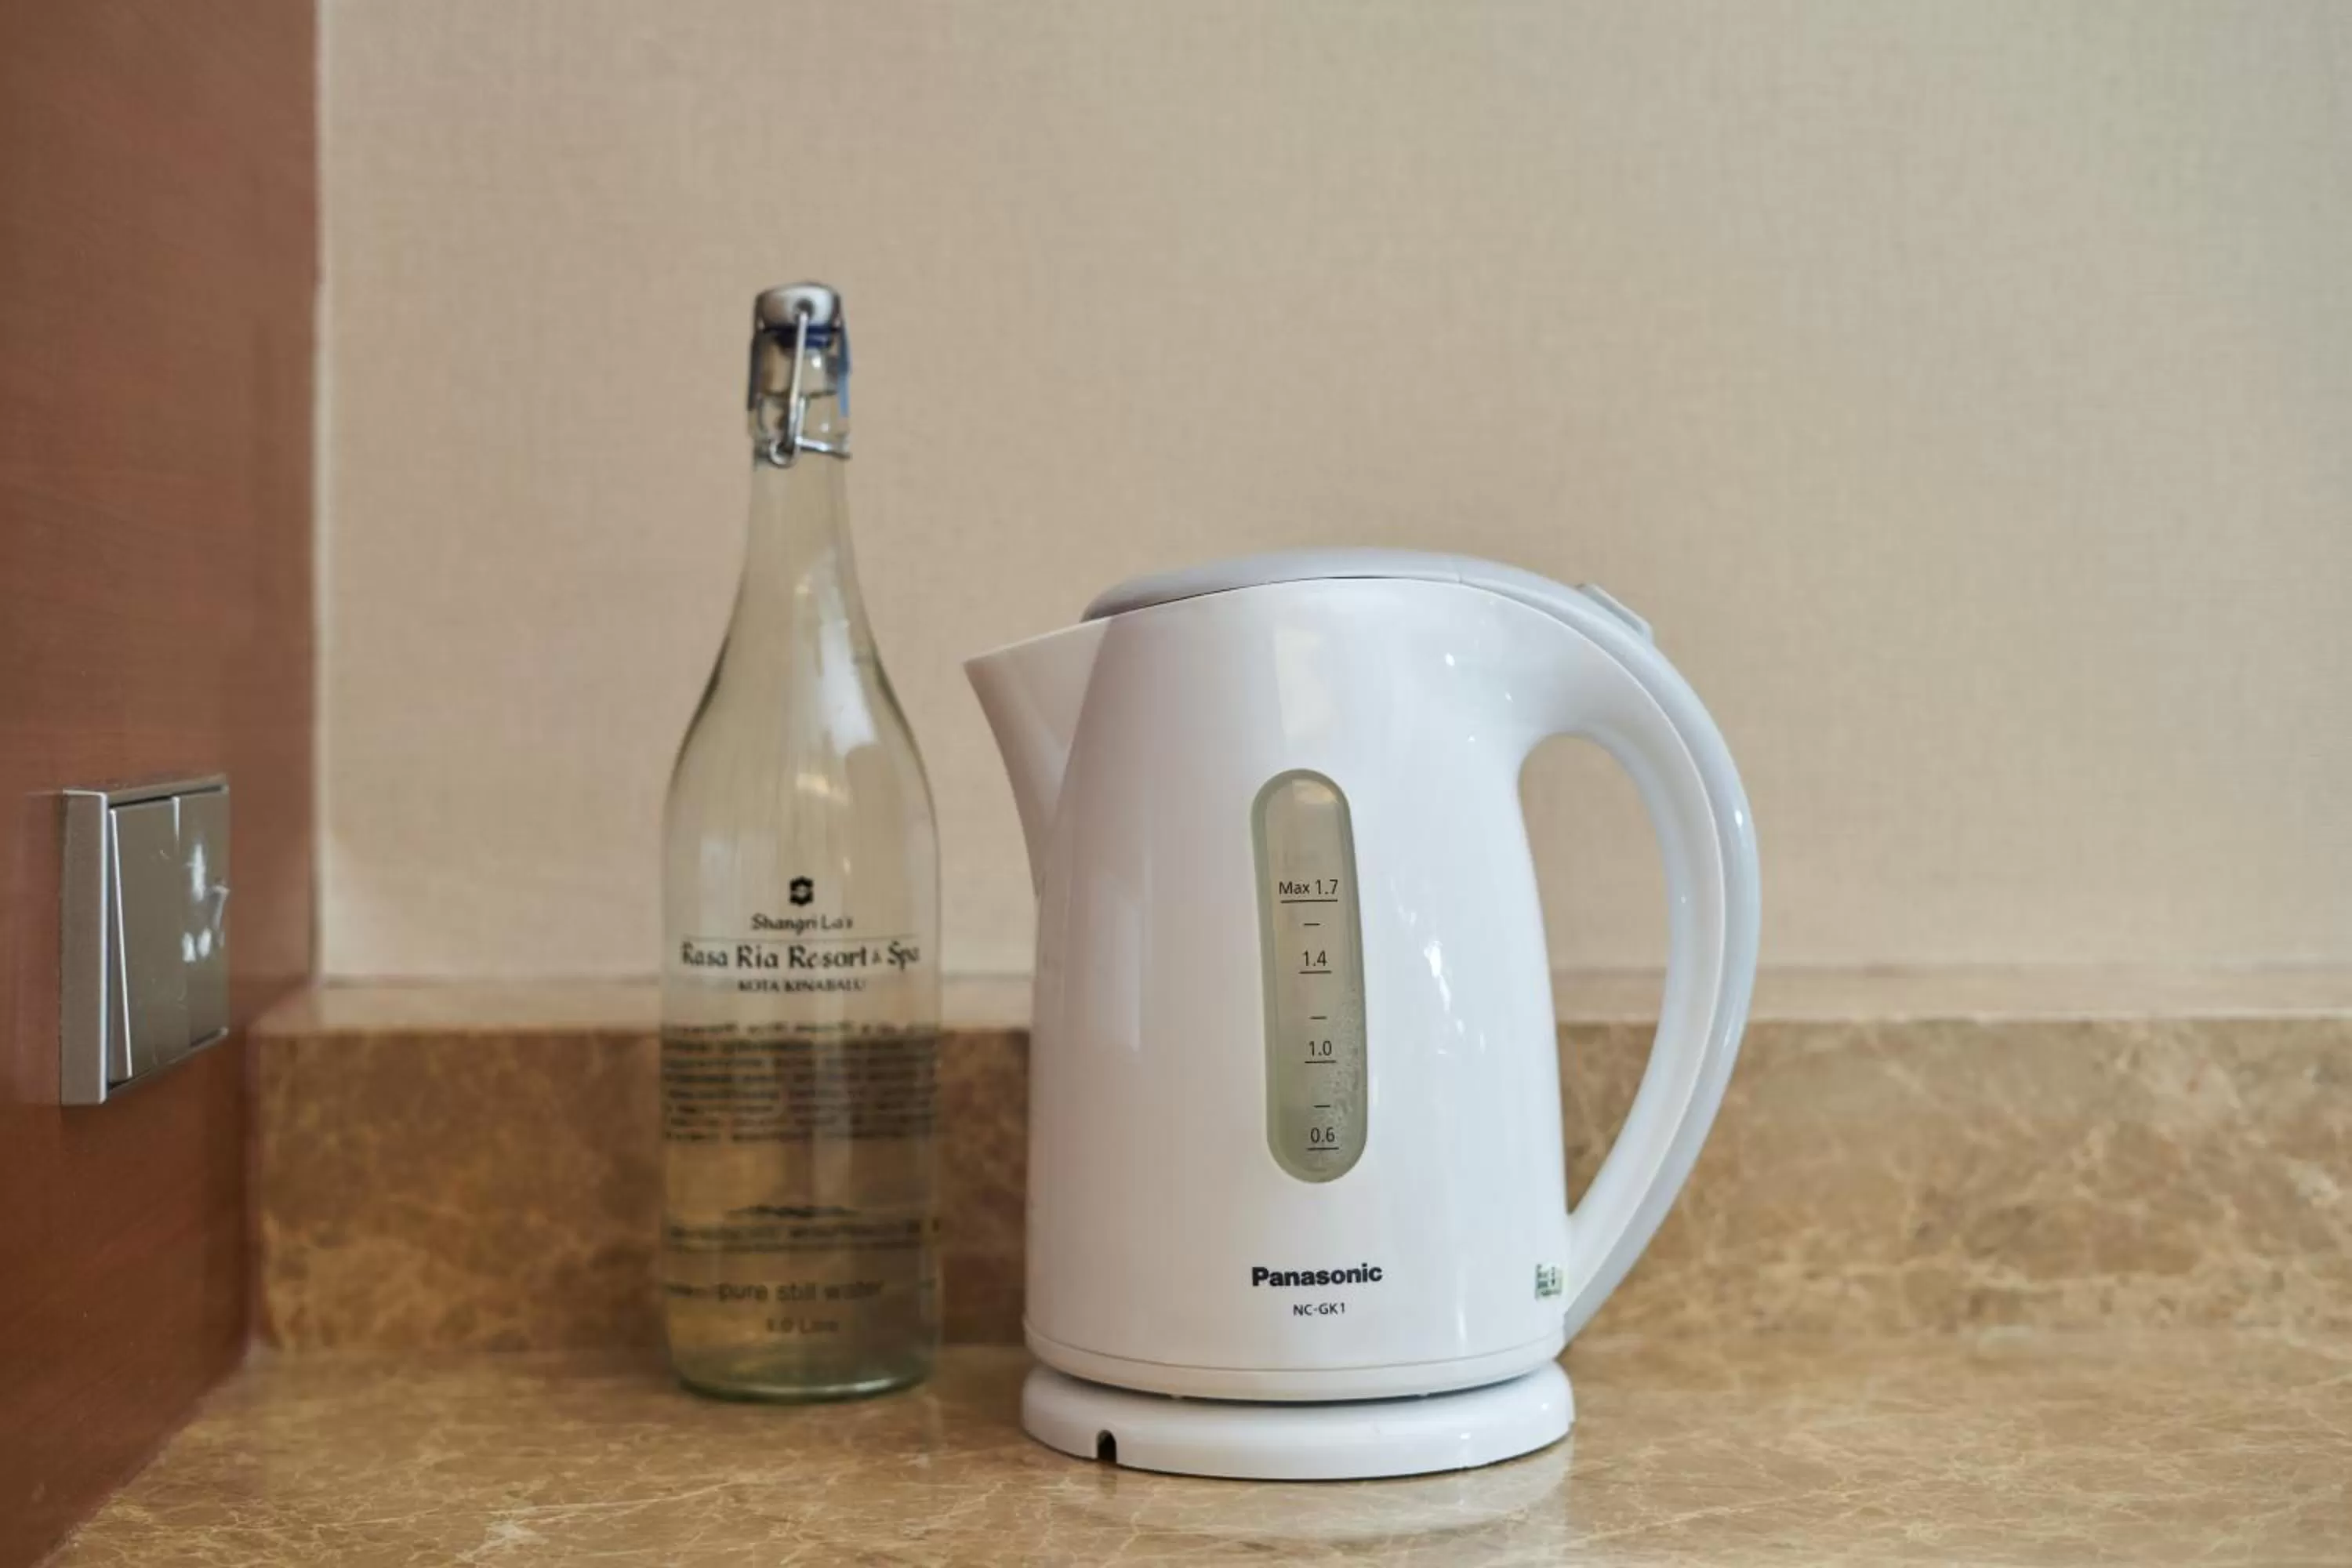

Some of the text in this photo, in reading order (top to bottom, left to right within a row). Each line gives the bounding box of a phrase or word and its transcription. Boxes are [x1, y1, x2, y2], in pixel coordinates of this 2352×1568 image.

[1279, 879, 1339, 895] Max 1.7
[680, 940, 729, 967] Rasa
[735, 944, 779, 969] Ria
[788, 944, 867, 969] Resort
[1302, 949, 1328, 967] 1.4
[1308, 1040, 1332, 1056] 1.0
[1309, 1127, 1335, 1143] 0.6
[1252, 1262, 1383, 1287] Panasonic
[1293, 1302, 1345, 1316] NC-GK1
